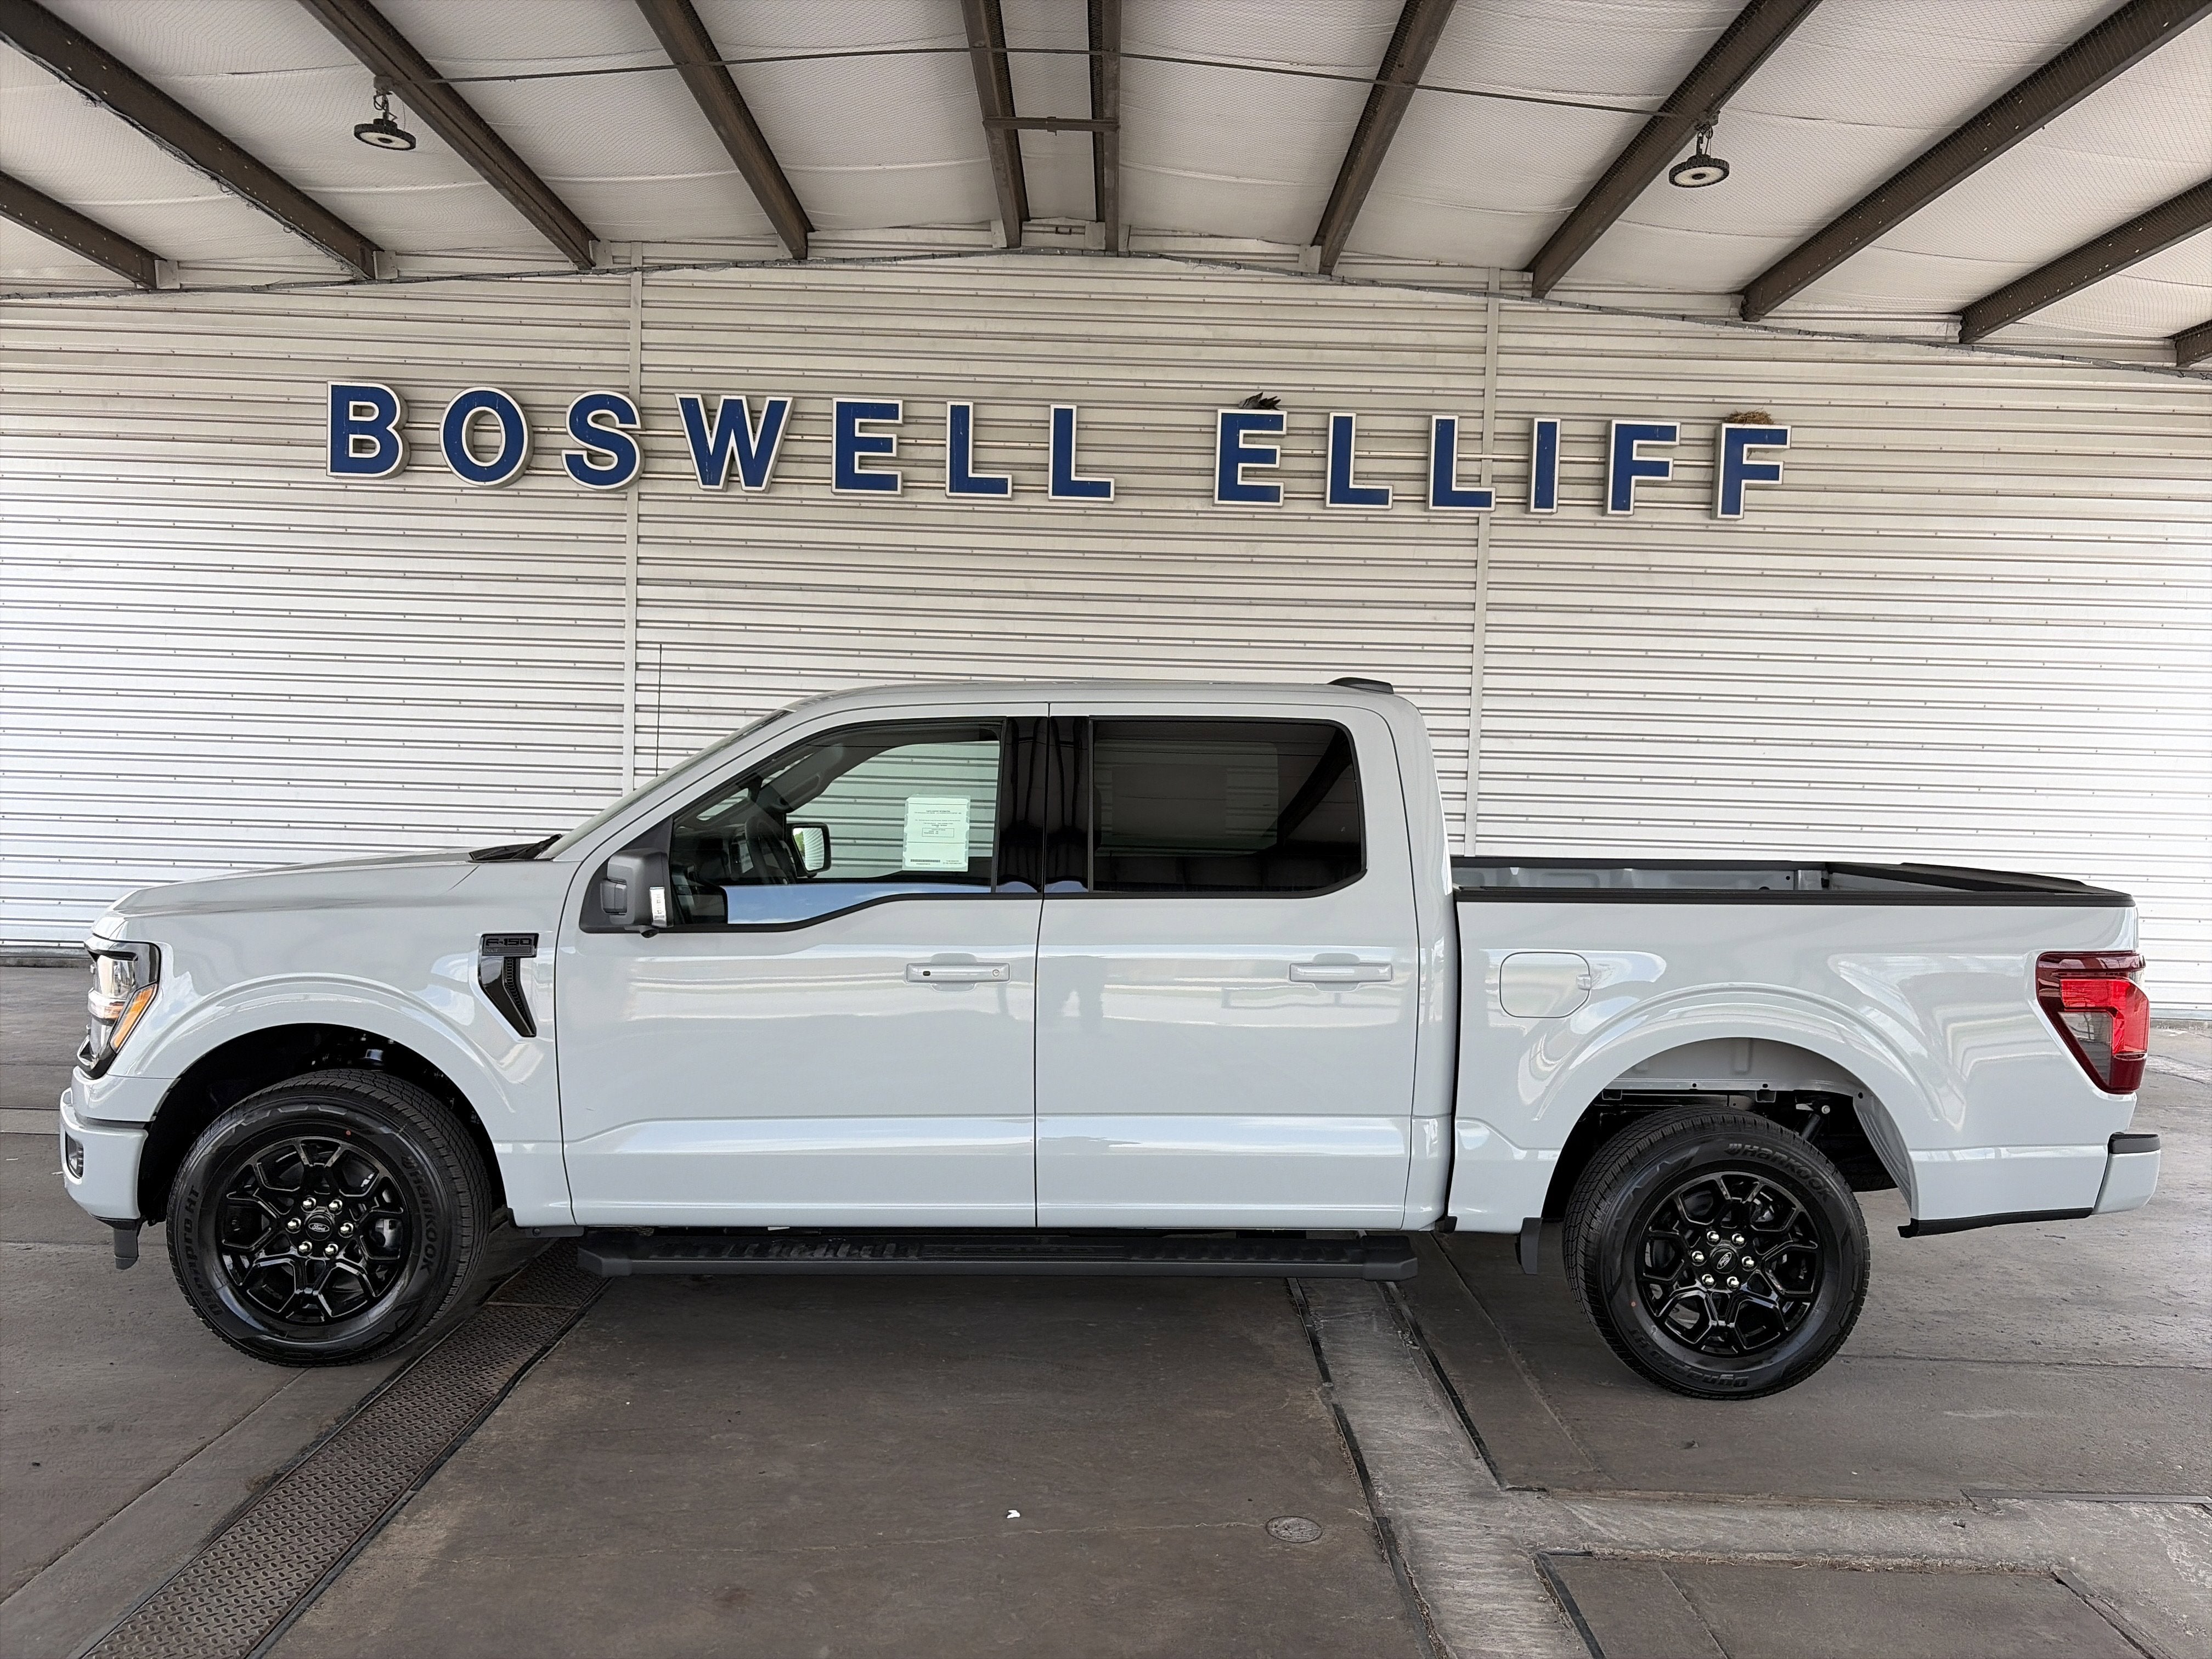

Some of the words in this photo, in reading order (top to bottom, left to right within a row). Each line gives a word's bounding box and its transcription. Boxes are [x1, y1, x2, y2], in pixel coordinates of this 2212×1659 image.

[327, 381, 1115, 503] BOSWELL
[1213, 409, 1791, 520] ELLIFF
[486, 938, 532, 946] F-150
